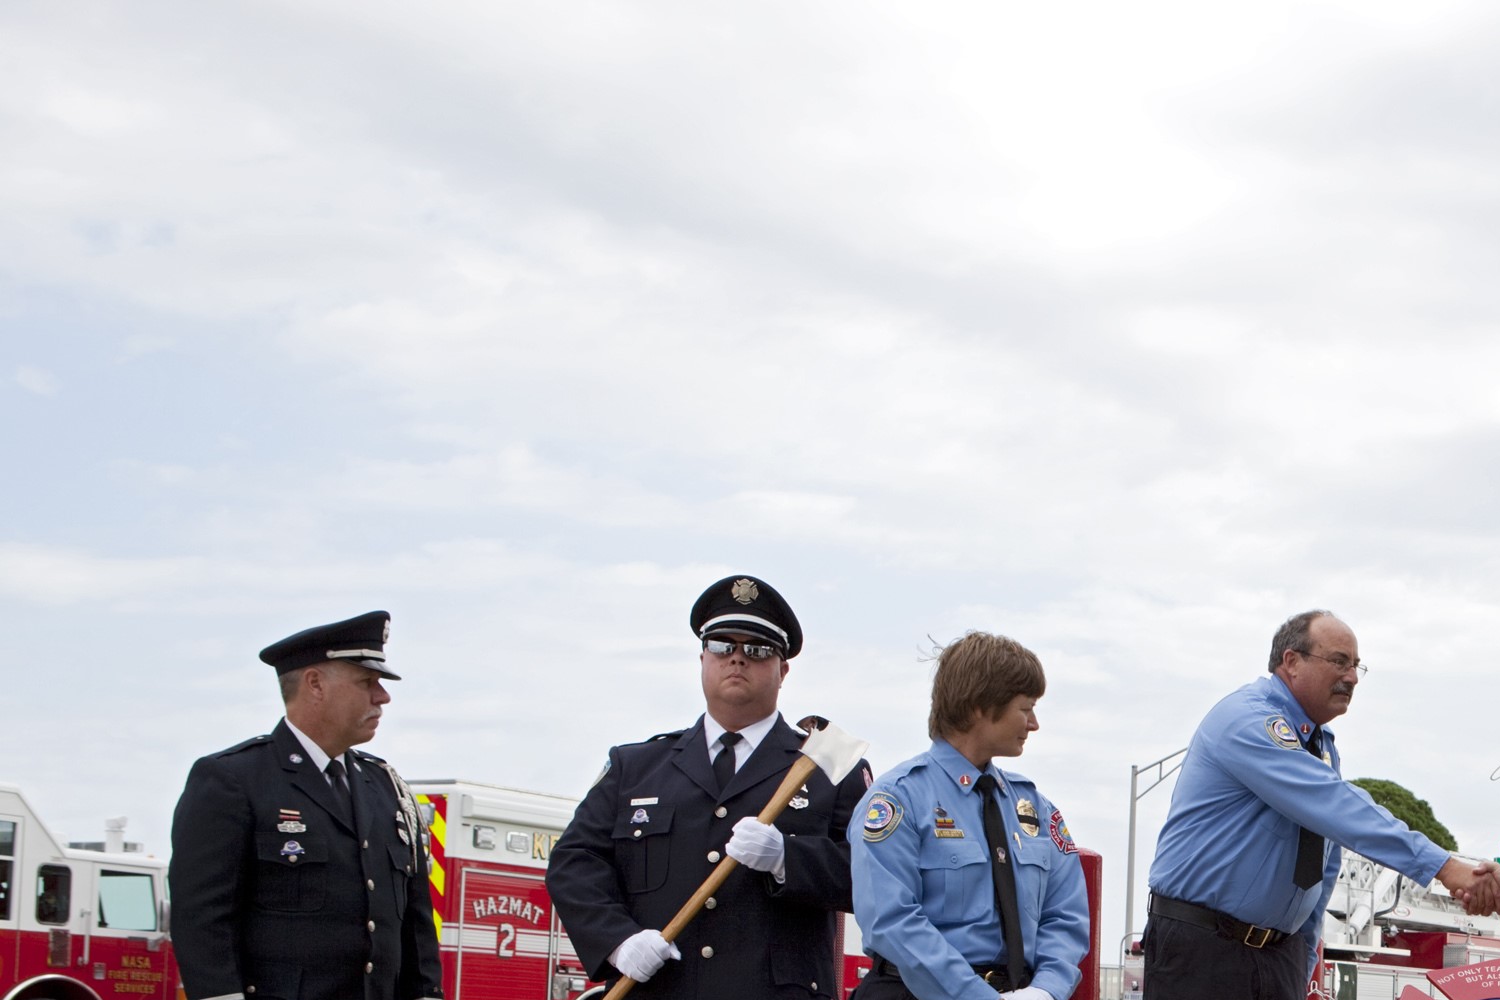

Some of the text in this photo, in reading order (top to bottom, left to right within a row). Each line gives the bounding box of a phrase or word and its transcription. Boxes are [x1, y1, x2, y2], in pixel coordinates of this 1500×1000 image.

[472, 895, 545, 925] HAZMAT
[498, 922, 516, 958] 2
[1437, 974, 1456, 986] NOT
[1457, 967, 1481, 978] ONLY
[1465, 974, 1483, 984] BUT
